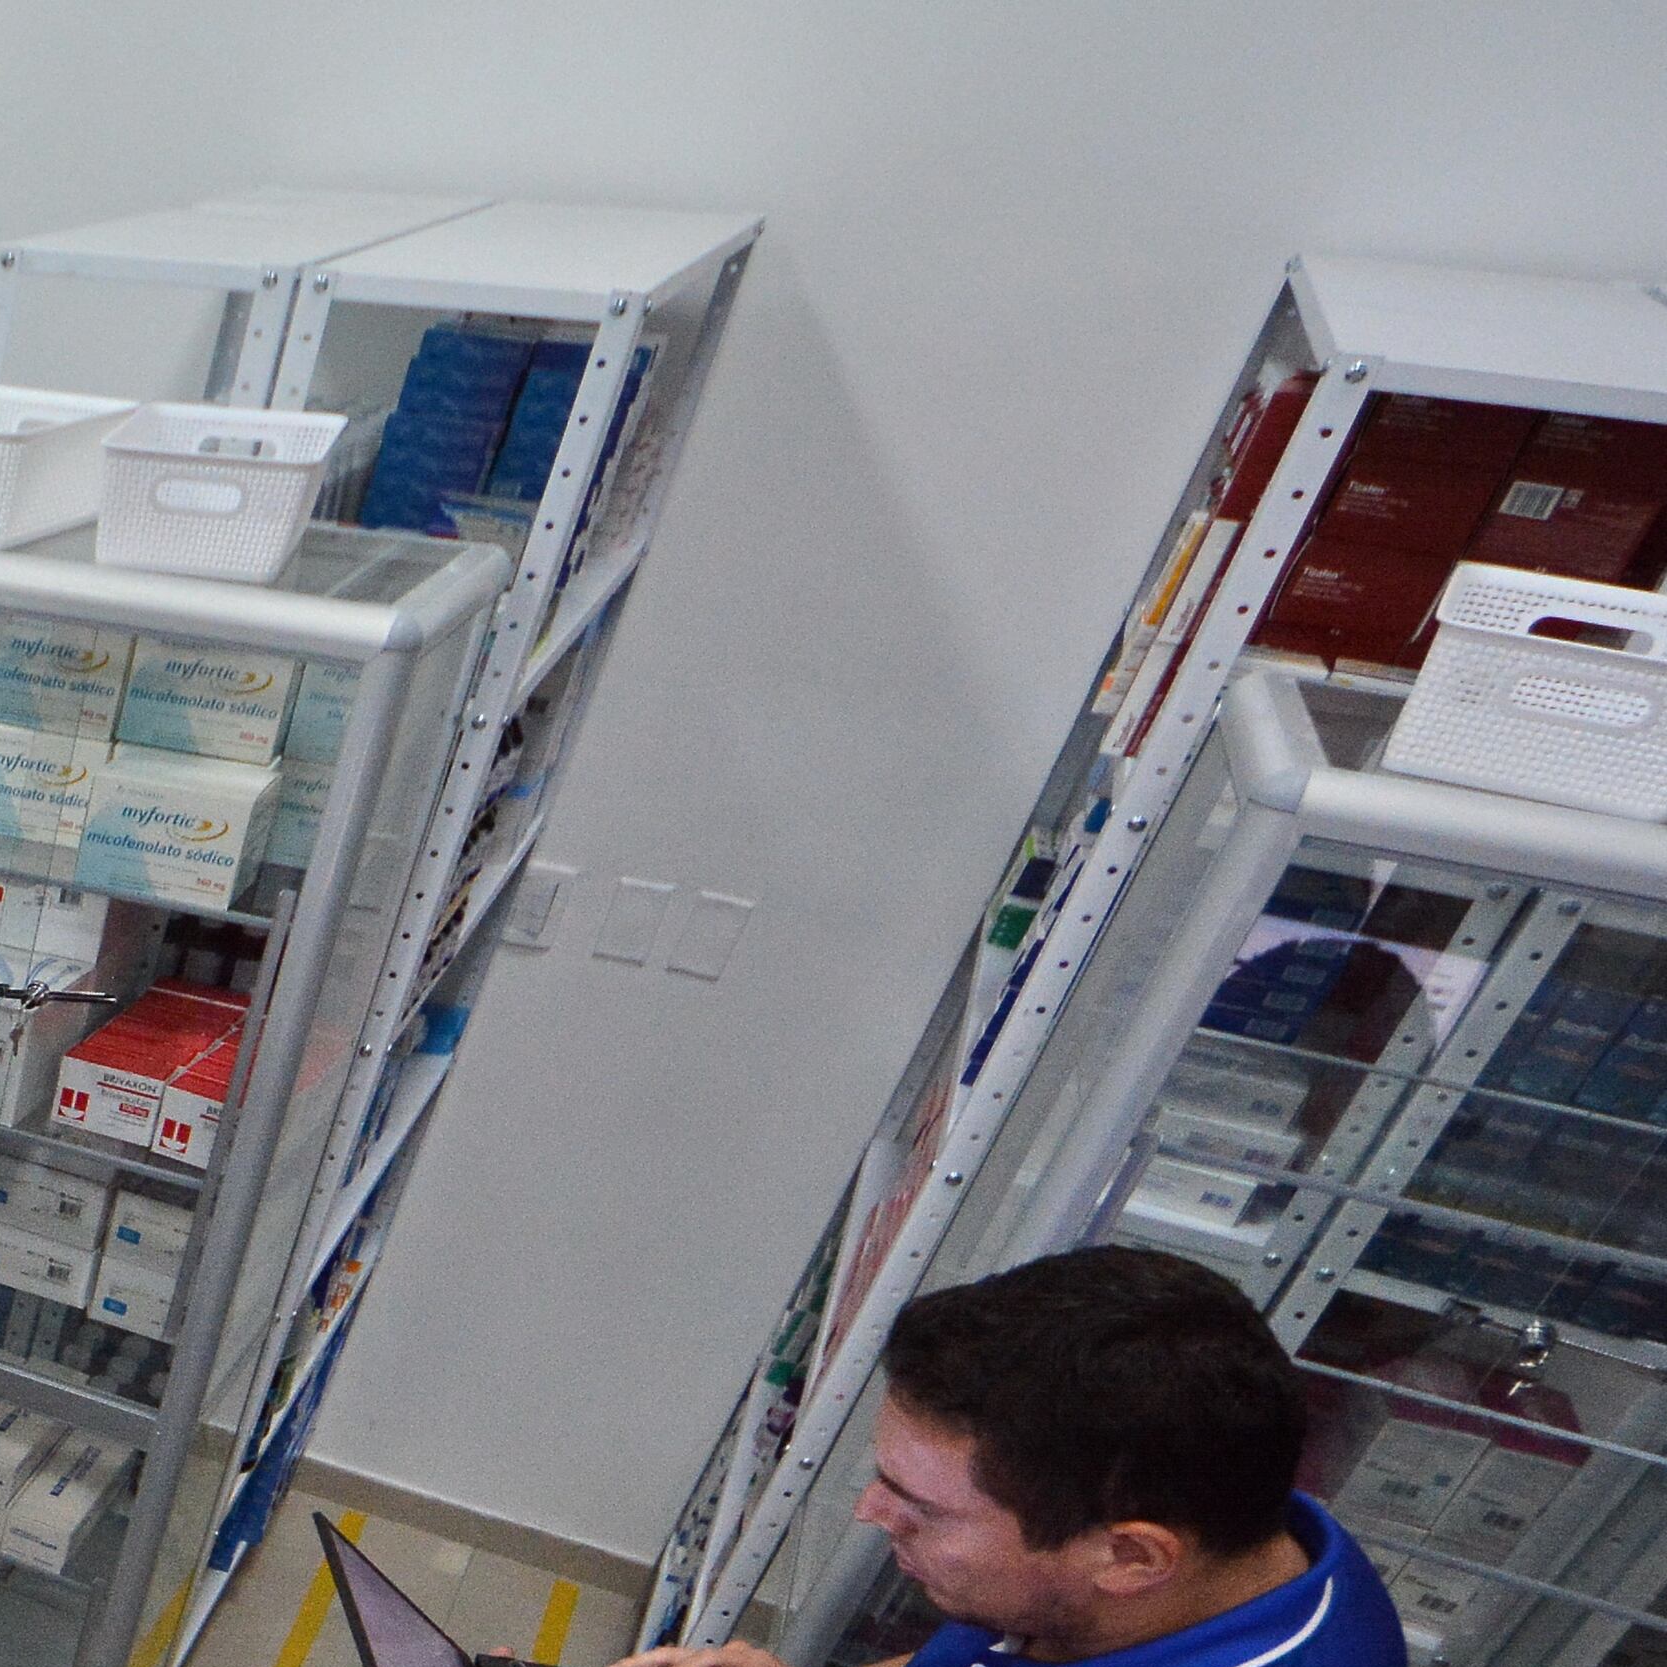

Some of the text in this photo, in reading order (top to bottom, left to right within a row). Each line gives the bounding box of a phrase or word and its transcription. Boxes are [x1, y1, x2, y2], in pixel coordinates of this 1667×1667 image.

[11, 638, 79, 660] myfortic
[165, 659, 239, 681] myfortic
[130, 687, 278, 719] micofenolato sódico
[122, 805, 196, 828] myfortic
[86, 829, 235, 867] micofenolato sódico
